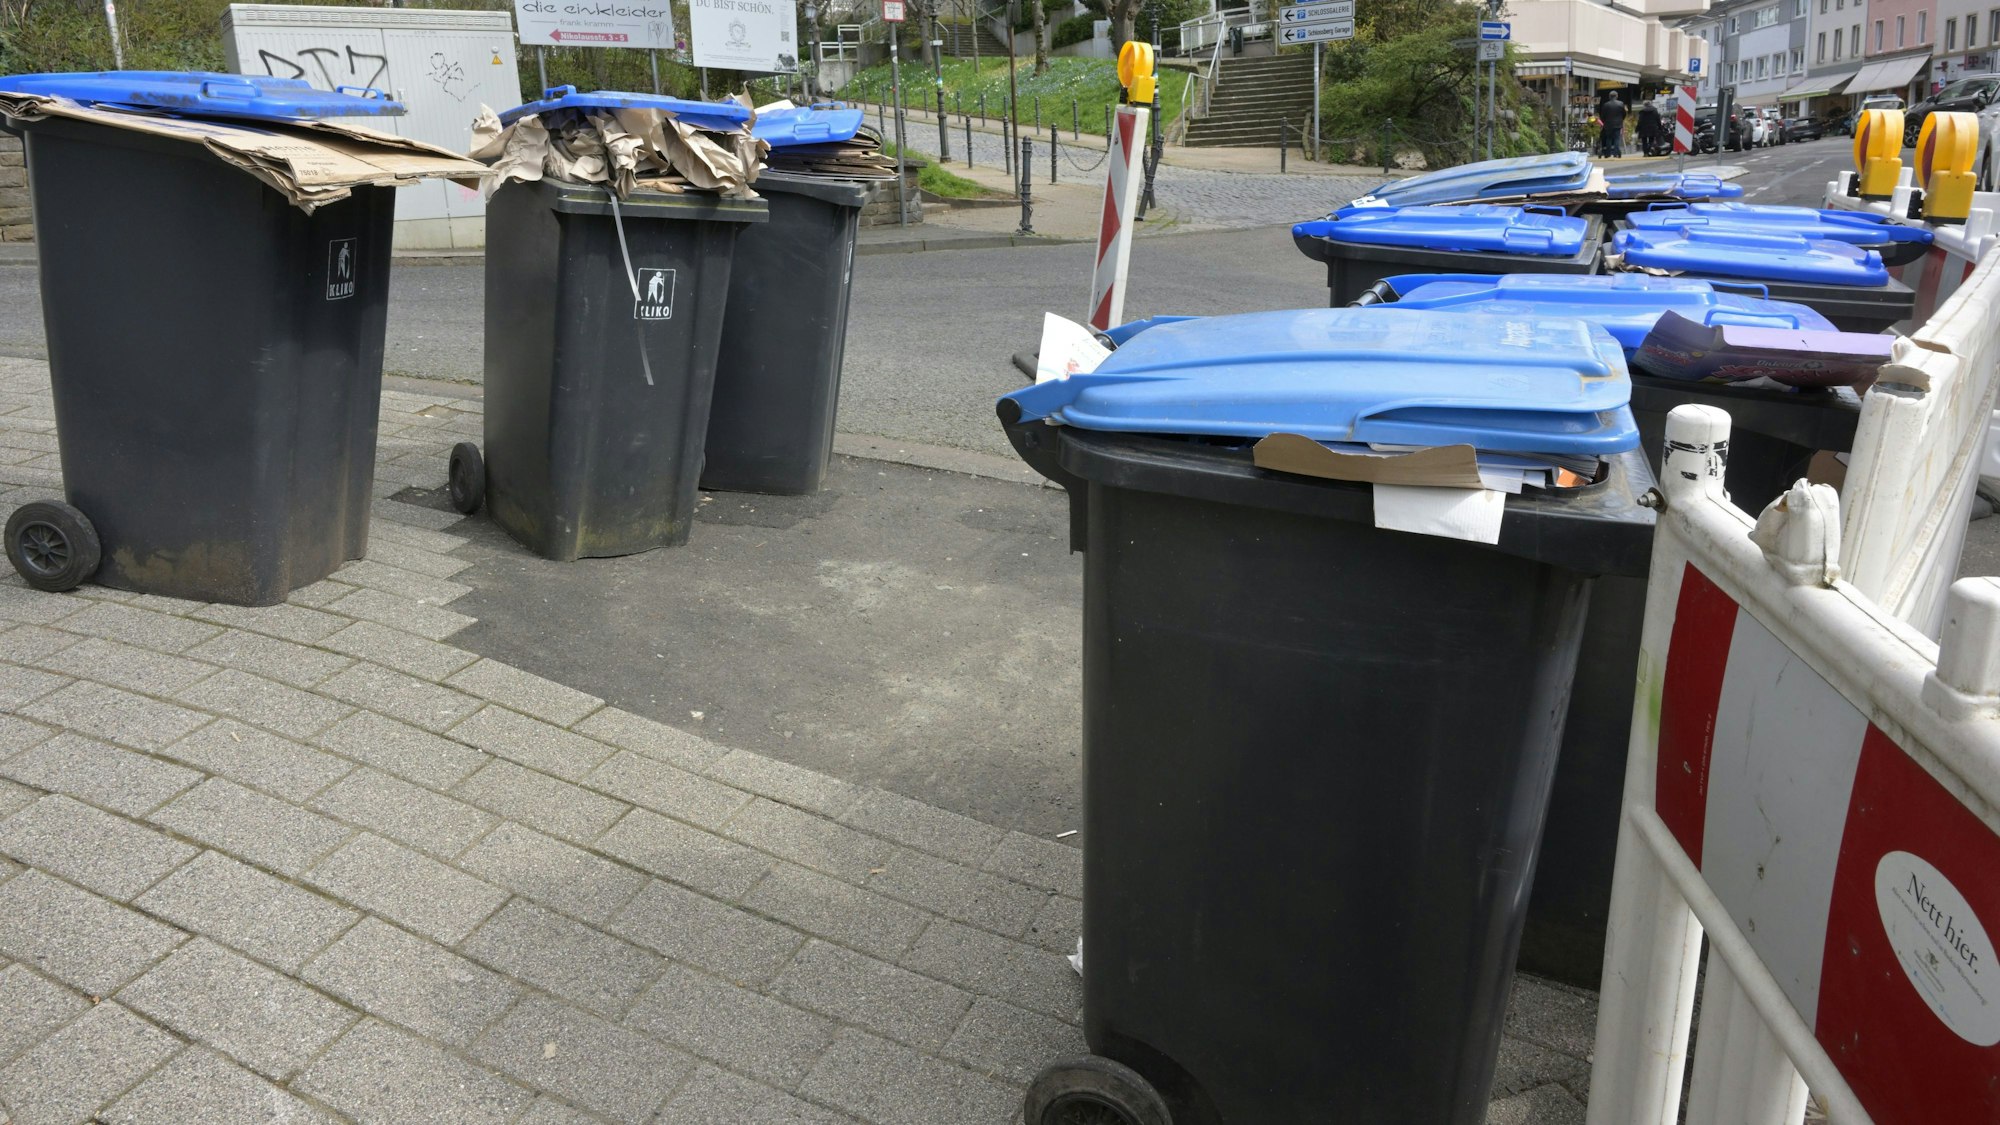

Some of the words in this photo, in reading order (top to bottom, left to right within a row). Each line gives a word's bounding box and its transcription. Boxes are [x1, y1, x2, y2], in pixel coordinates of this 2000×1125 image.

[522, 0, 557, 13] die
[564, 2, 666, 18] einkleider
[713, 0, 735, 10] BIST
[737, 1, 774, 15] SCHÖN.
[1308, 6, 1350, 16] SCHLOSSGALERIE
[560, 32, 605, 41] Nikolausstr.
[329, 281, 353, 297] KLIKO
[1906, 872, 1943, 929] Nett
[1943, 916, 1978, 975] hier.
